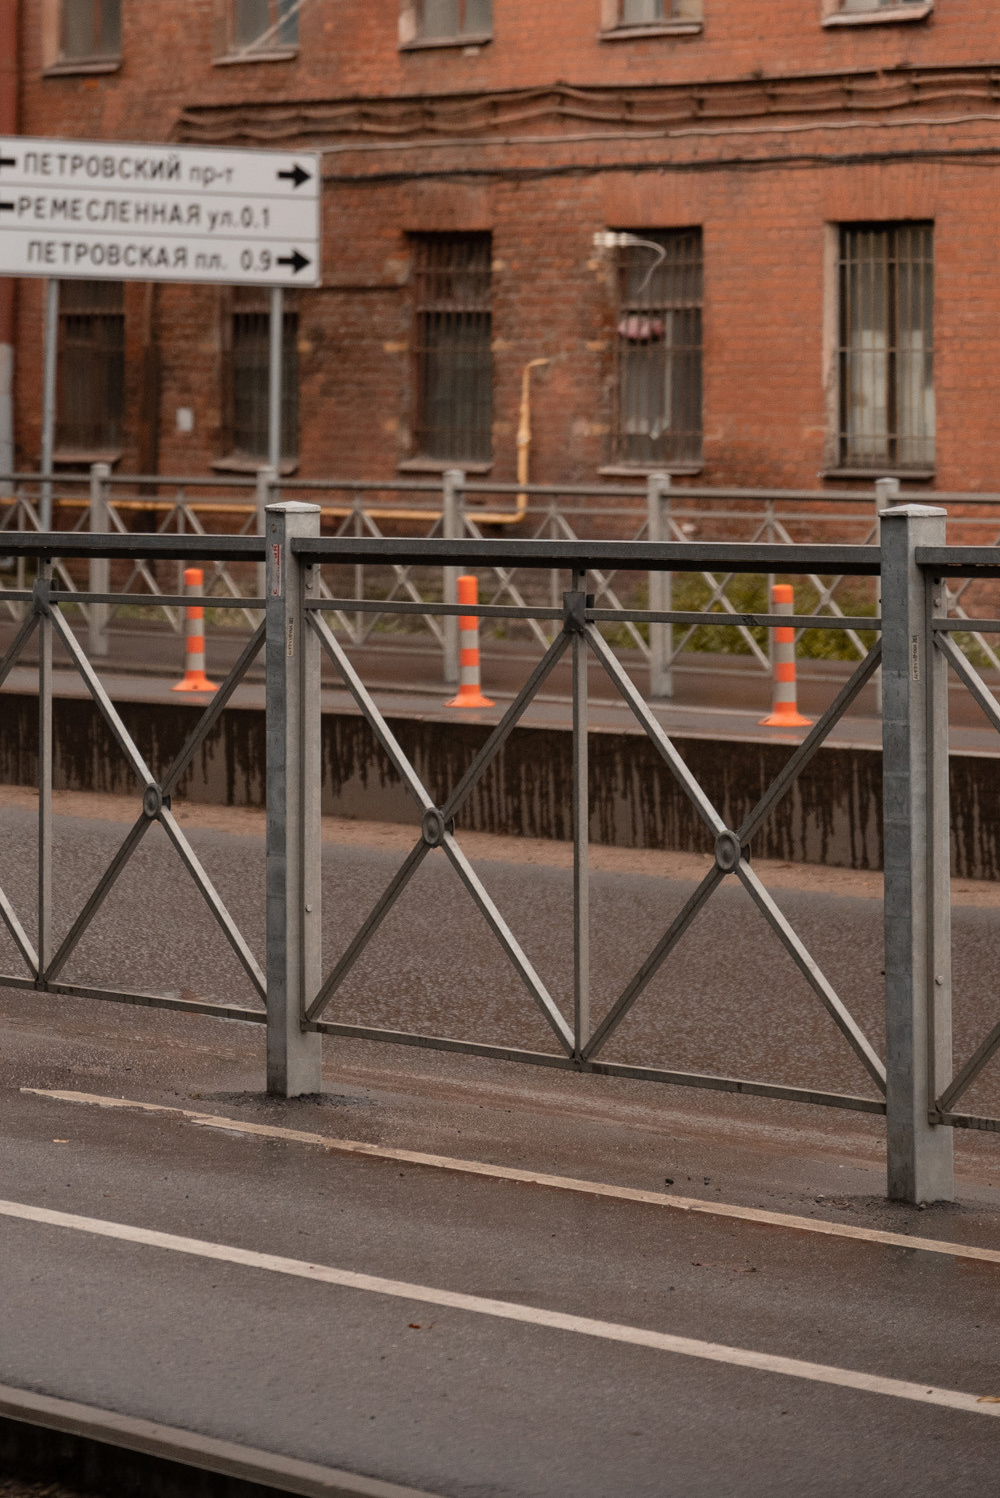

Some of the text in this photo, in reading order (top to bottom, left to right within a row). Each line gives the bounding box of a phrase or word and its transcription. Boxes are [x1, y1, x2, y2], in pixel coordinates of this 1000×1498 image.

[23, 153, 234, 187] ПЕТРОВСКИЙ пр-т
[18, 197, 200, 223] РЕМЕСЛЕННАЯ
[27, 240, 187, 269] ПЕТРОВСКАЯ
[240, 249, 271, 272] 0.9
